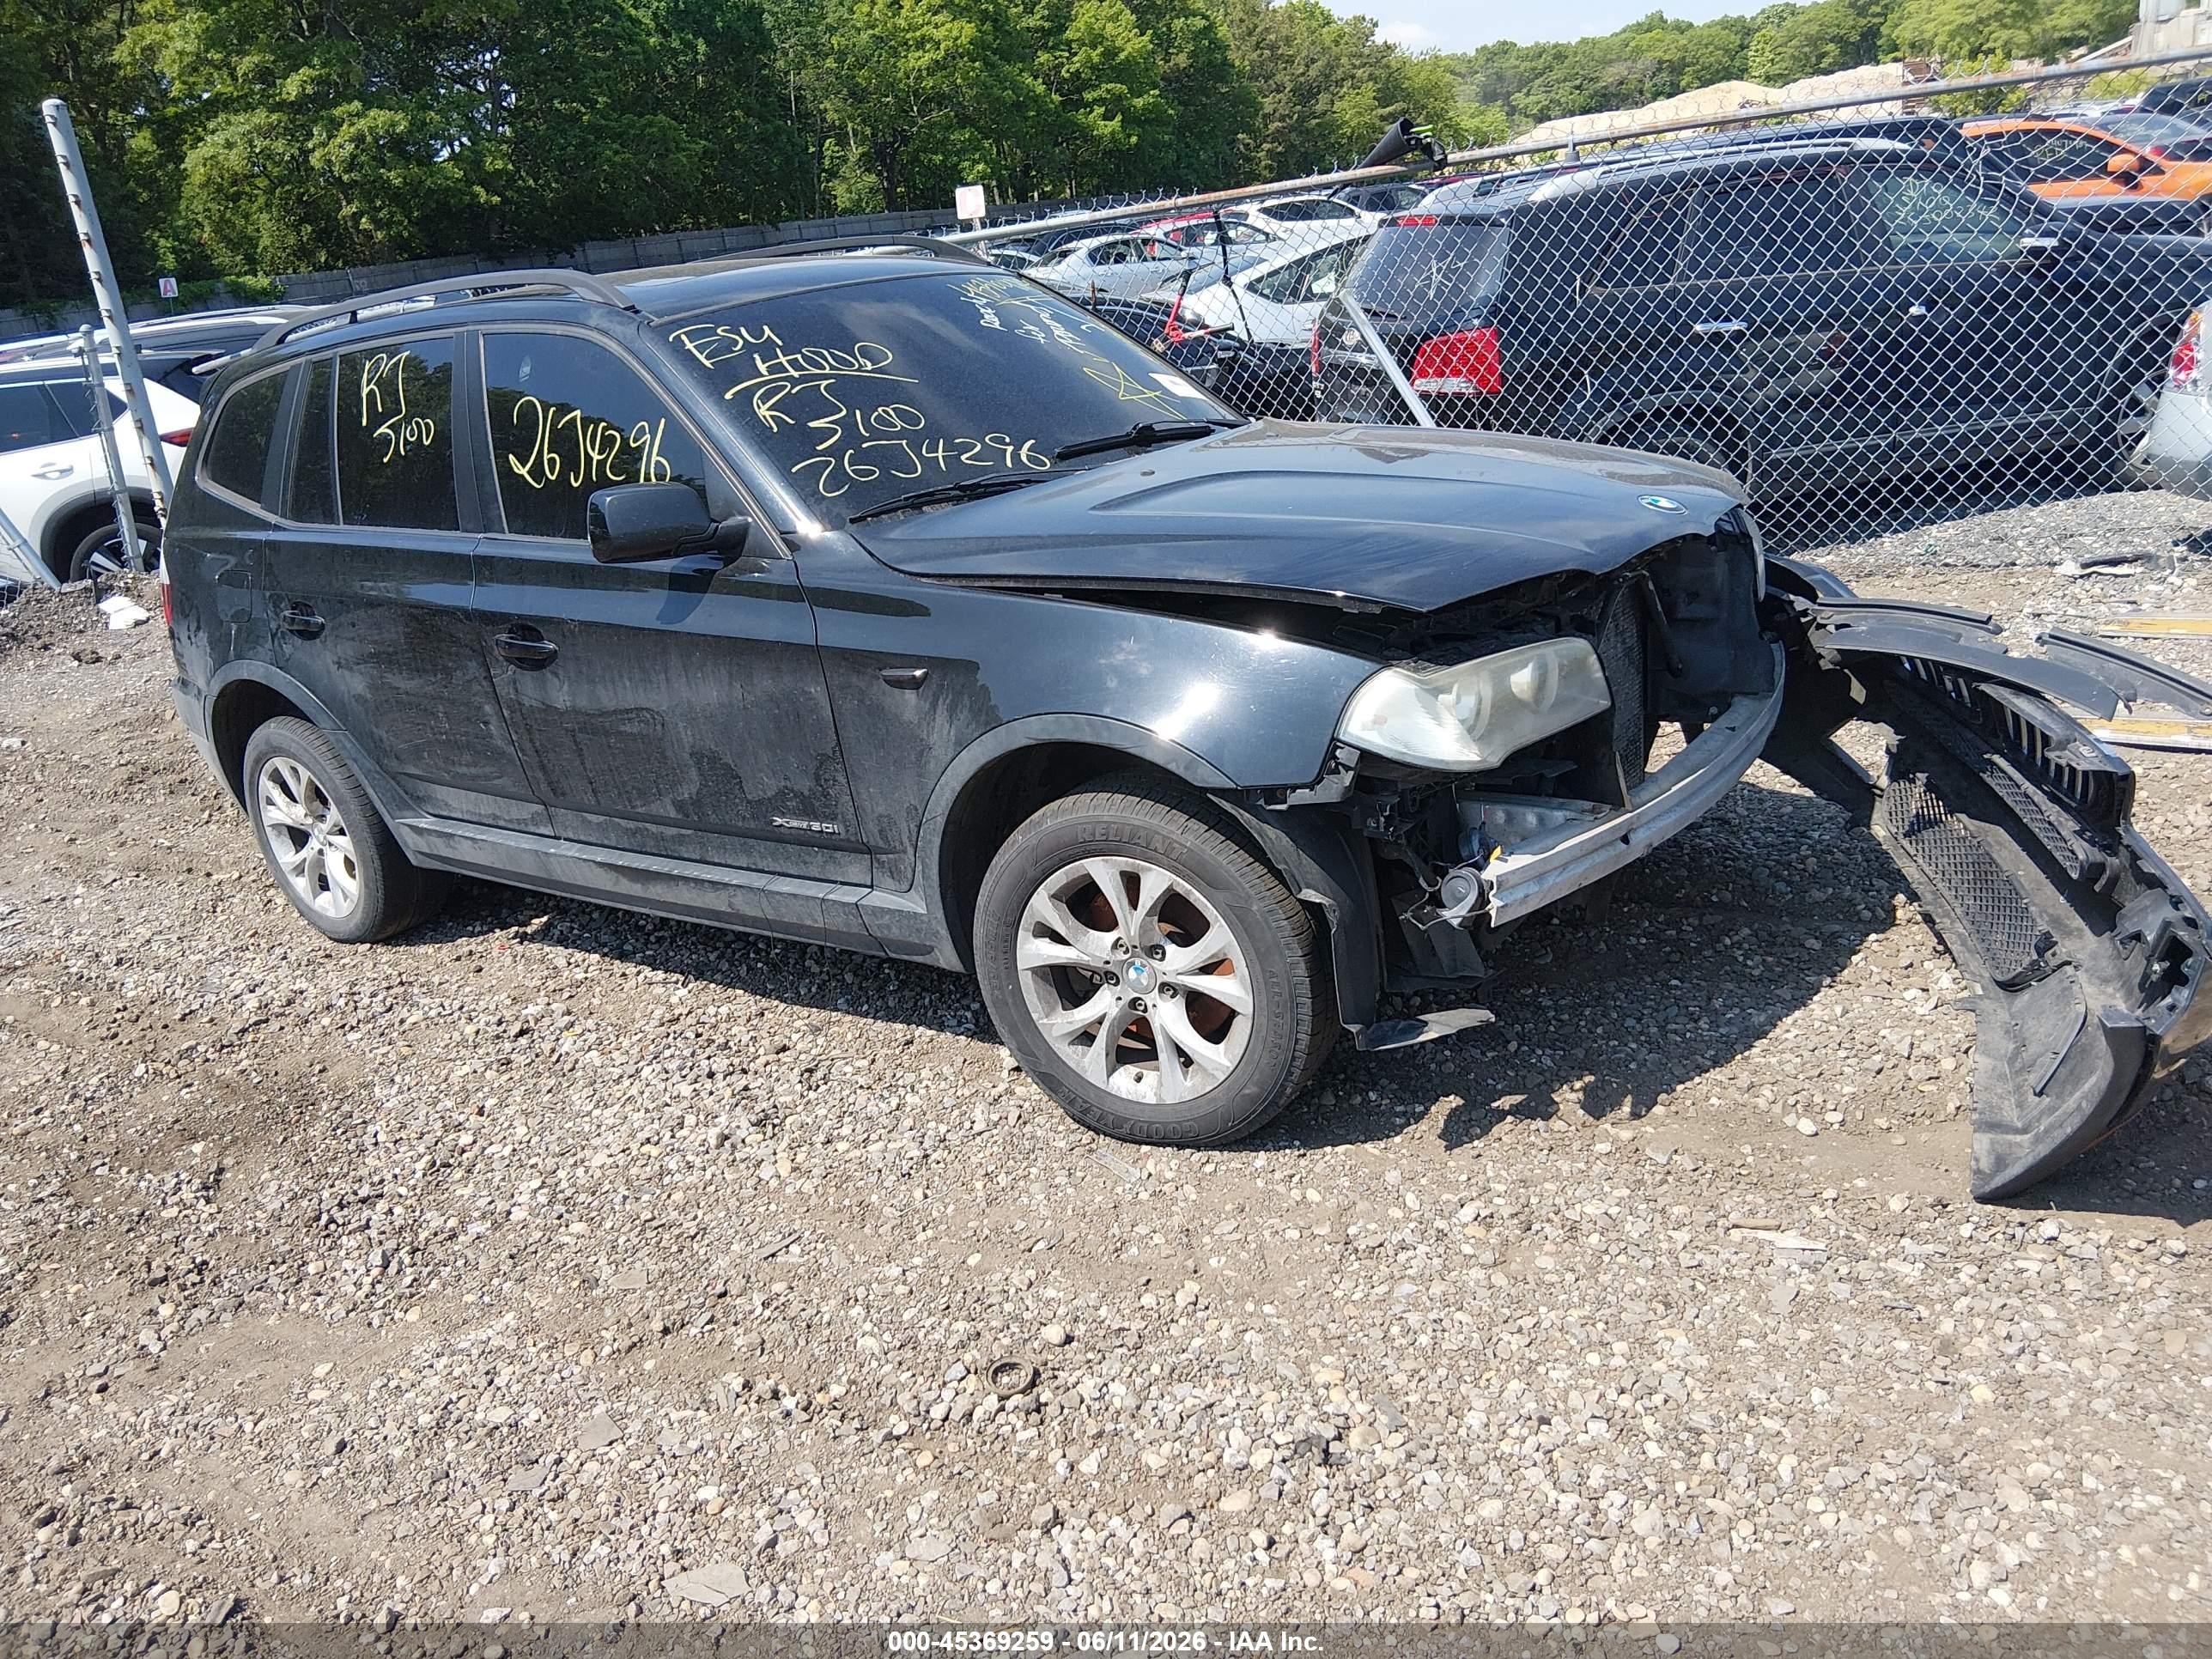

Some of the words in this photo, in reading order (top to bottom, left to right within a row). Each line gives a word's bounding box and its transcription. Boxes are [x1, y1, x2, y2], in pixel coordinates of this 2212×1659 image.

[163, 279, 177, 295] A
[791, 433, 1052, 497] 26J4296
[1076, 823, 1188, 860] RELIANT
